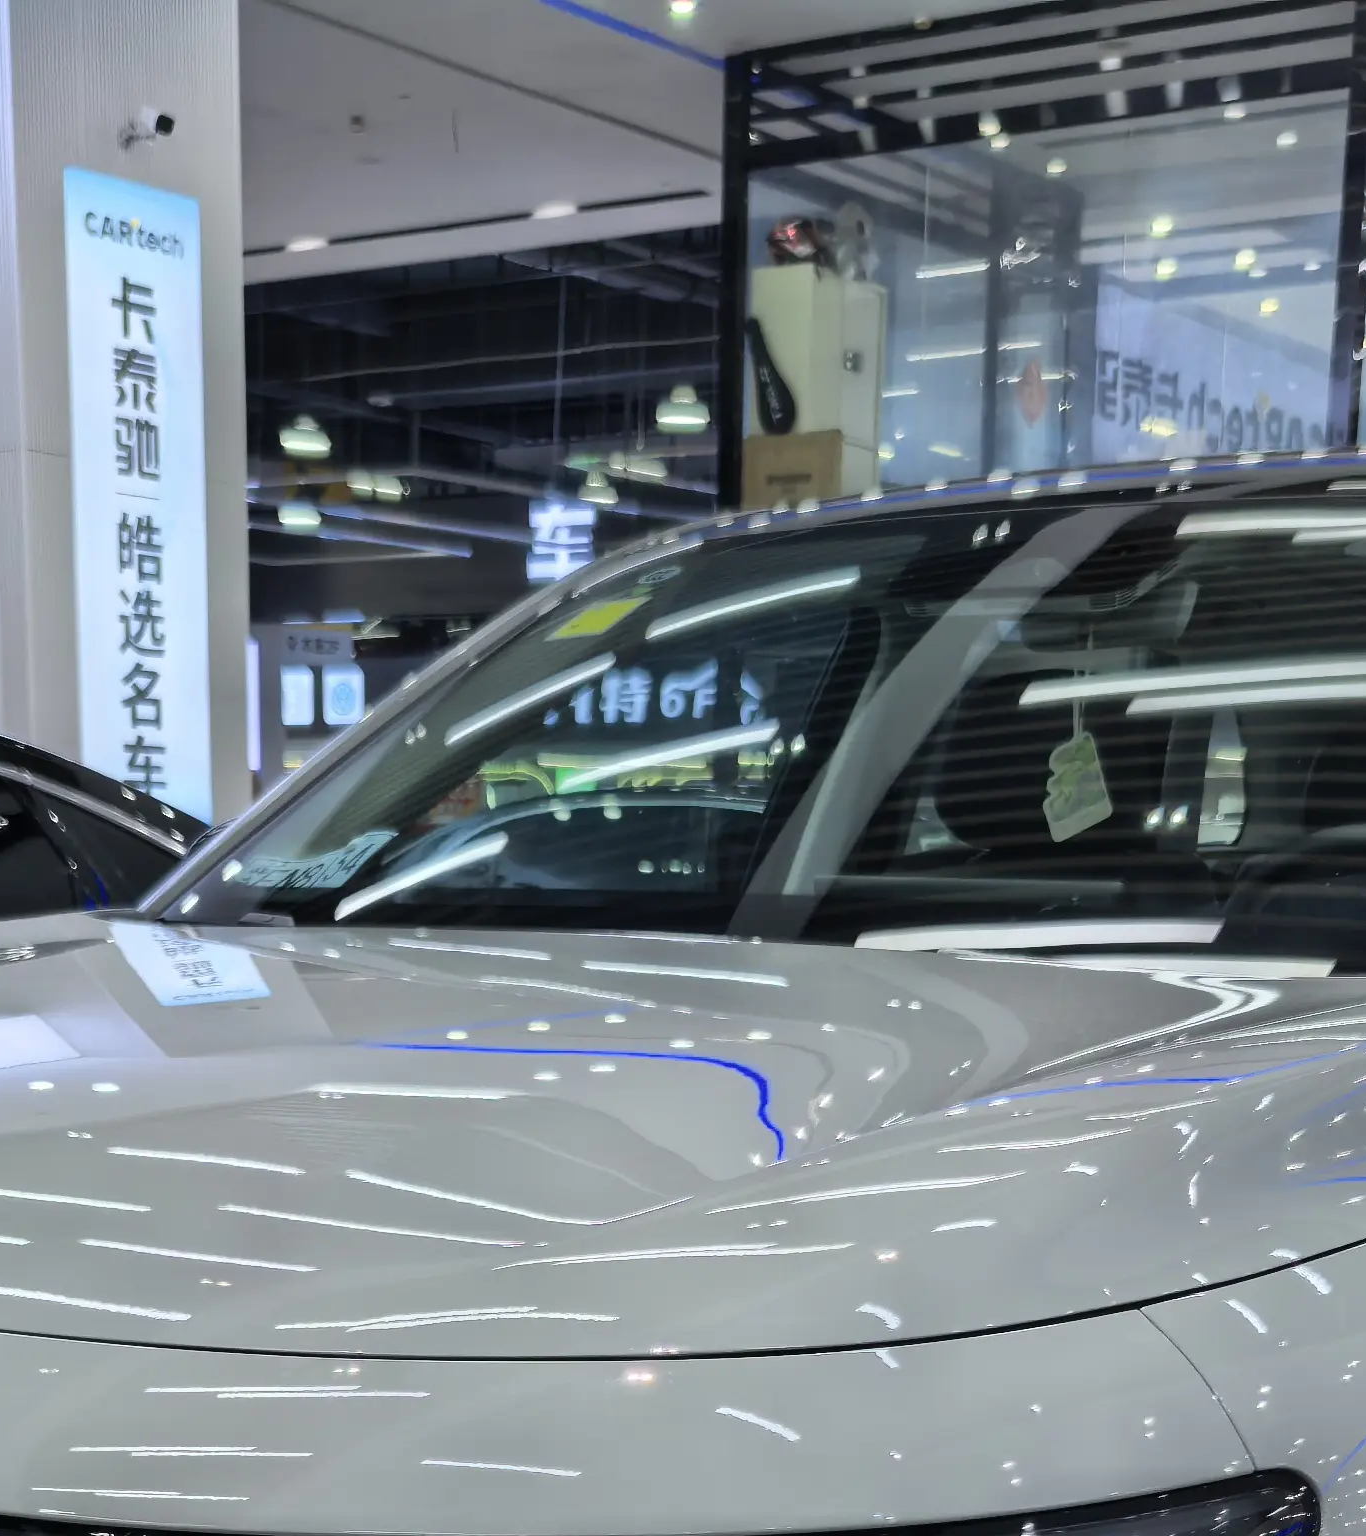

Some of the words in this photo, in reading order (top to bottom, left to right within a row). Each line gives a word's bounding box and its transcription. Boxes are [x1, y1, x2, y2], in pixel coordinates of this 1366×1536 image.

[84, 211, 185, 259] CARtech
[111, 276, 161, 482] 卡泰驰
[117, 512, 169, 794] 皓选名车
